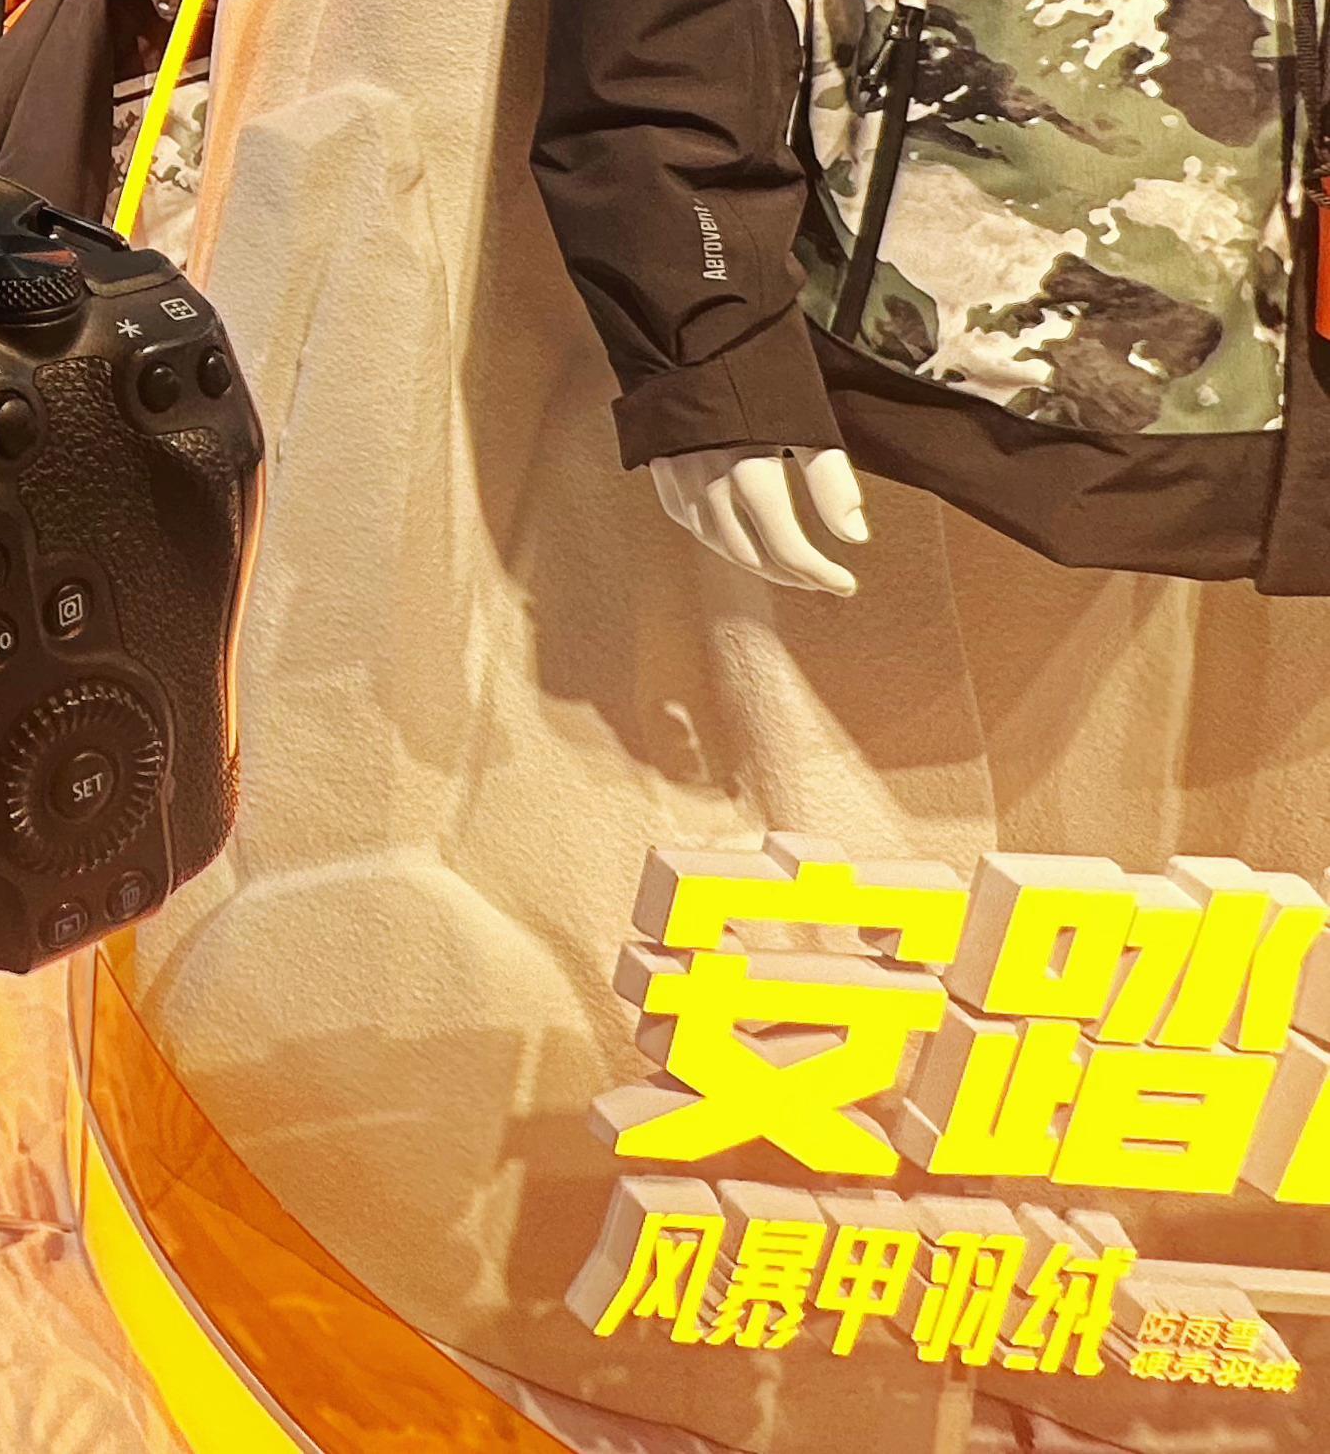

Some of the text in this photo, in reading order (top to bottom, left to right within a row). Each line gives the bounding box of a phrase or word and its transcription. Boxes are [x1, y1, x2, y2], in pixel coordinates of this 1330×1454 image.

[72, 773, 103, 802] SET
[615, 861, 1330, 1206] 安踏
[594, 1212, 1137, 1376] 风暴甲羽绒
